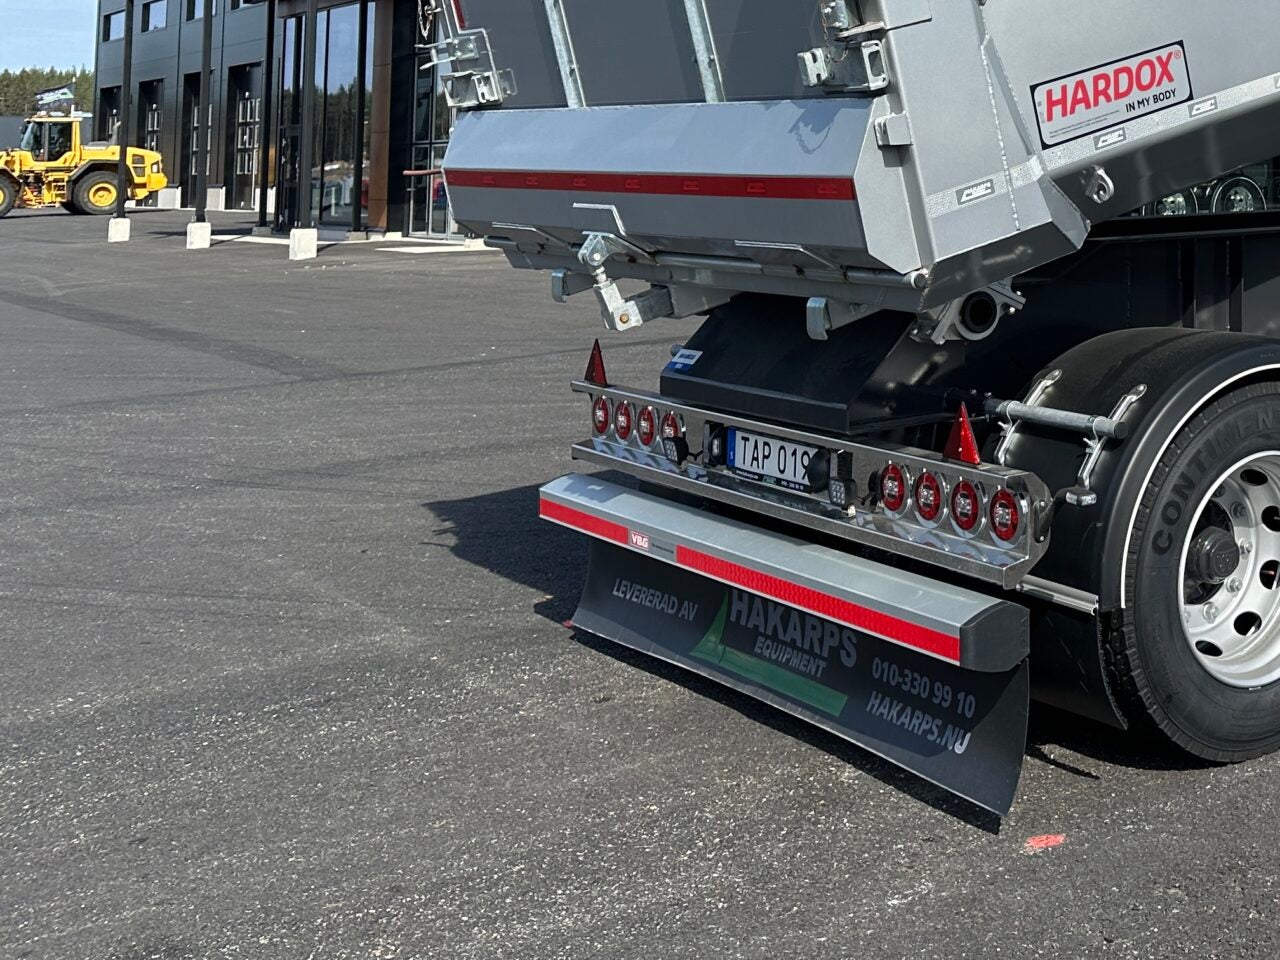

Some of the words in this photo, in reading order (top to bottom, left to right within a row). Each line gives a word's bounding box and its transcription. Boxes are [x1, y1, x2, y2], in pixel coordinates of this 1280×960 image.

[1125, 102, 1136, 114] IN
[1138, 96, 1151, 109] MY
[1153, 88, 1177, 104] BODY
[741, 436, 772, 470] TAP
[777, 444, 812, 481] 019
[631, 532, 649, 548] VBG
[612, 577, 678, 615] LEVERERAD
[678, 600, 699, 622] AV
[728, 589, 857, 668] HAKARPS
[754, 637, 827, 678] EQUIPMENT
[871, 657, 930, 699] 010-330
[932, 681, 952, 708] 99
[956, 691, 976, 719] 10
[865, 691, 972, 755] HAKARPS.NU
